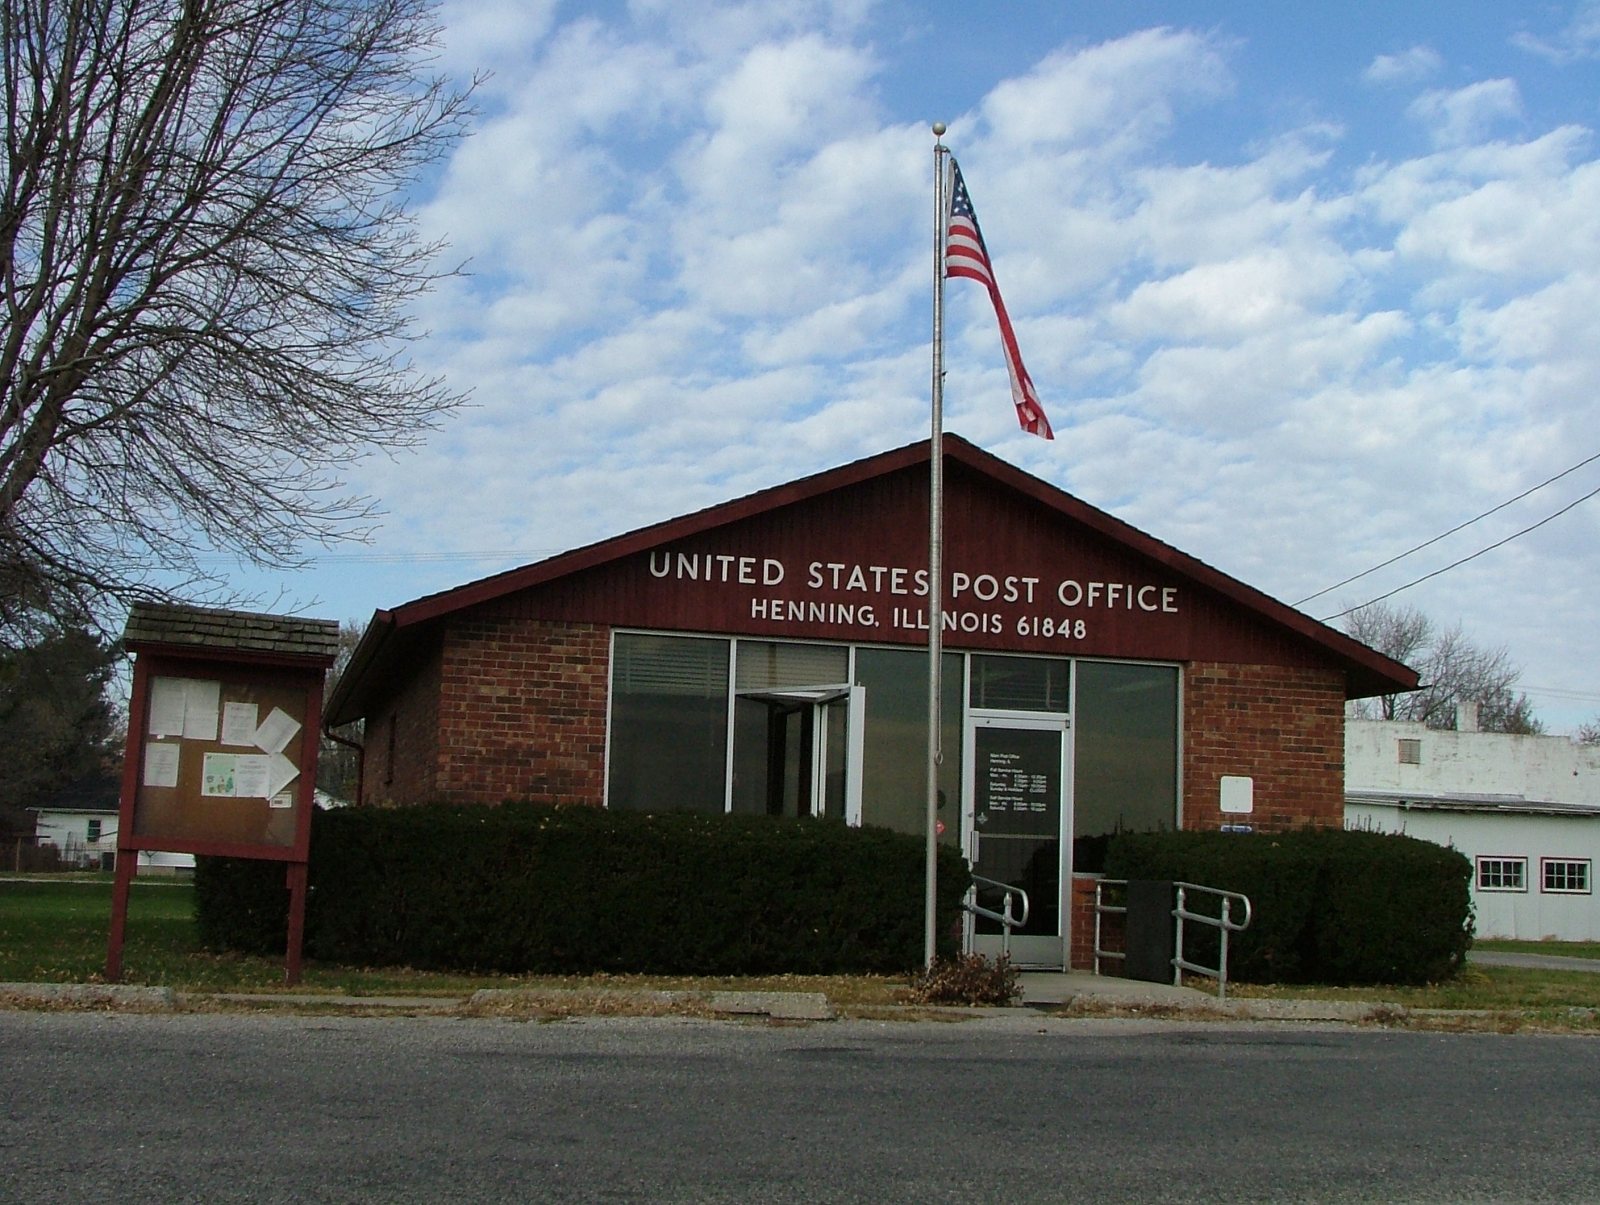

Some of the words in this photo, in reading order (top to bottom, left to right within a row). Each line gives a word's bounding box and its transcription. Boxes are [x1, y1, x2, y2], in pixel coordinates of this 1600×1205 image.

[649, 551, 785, 586] UNITED
[807, 561, 930, 596] STATES
[952, 572, 1040, 603] POST
[1057, 579, 1179, 613] OFFICE
[751, 598, 880, 628] HENNING,
[893, 607, 1003, 634] ILLNOIS
[1016, 616, 1087, 640] 61848
